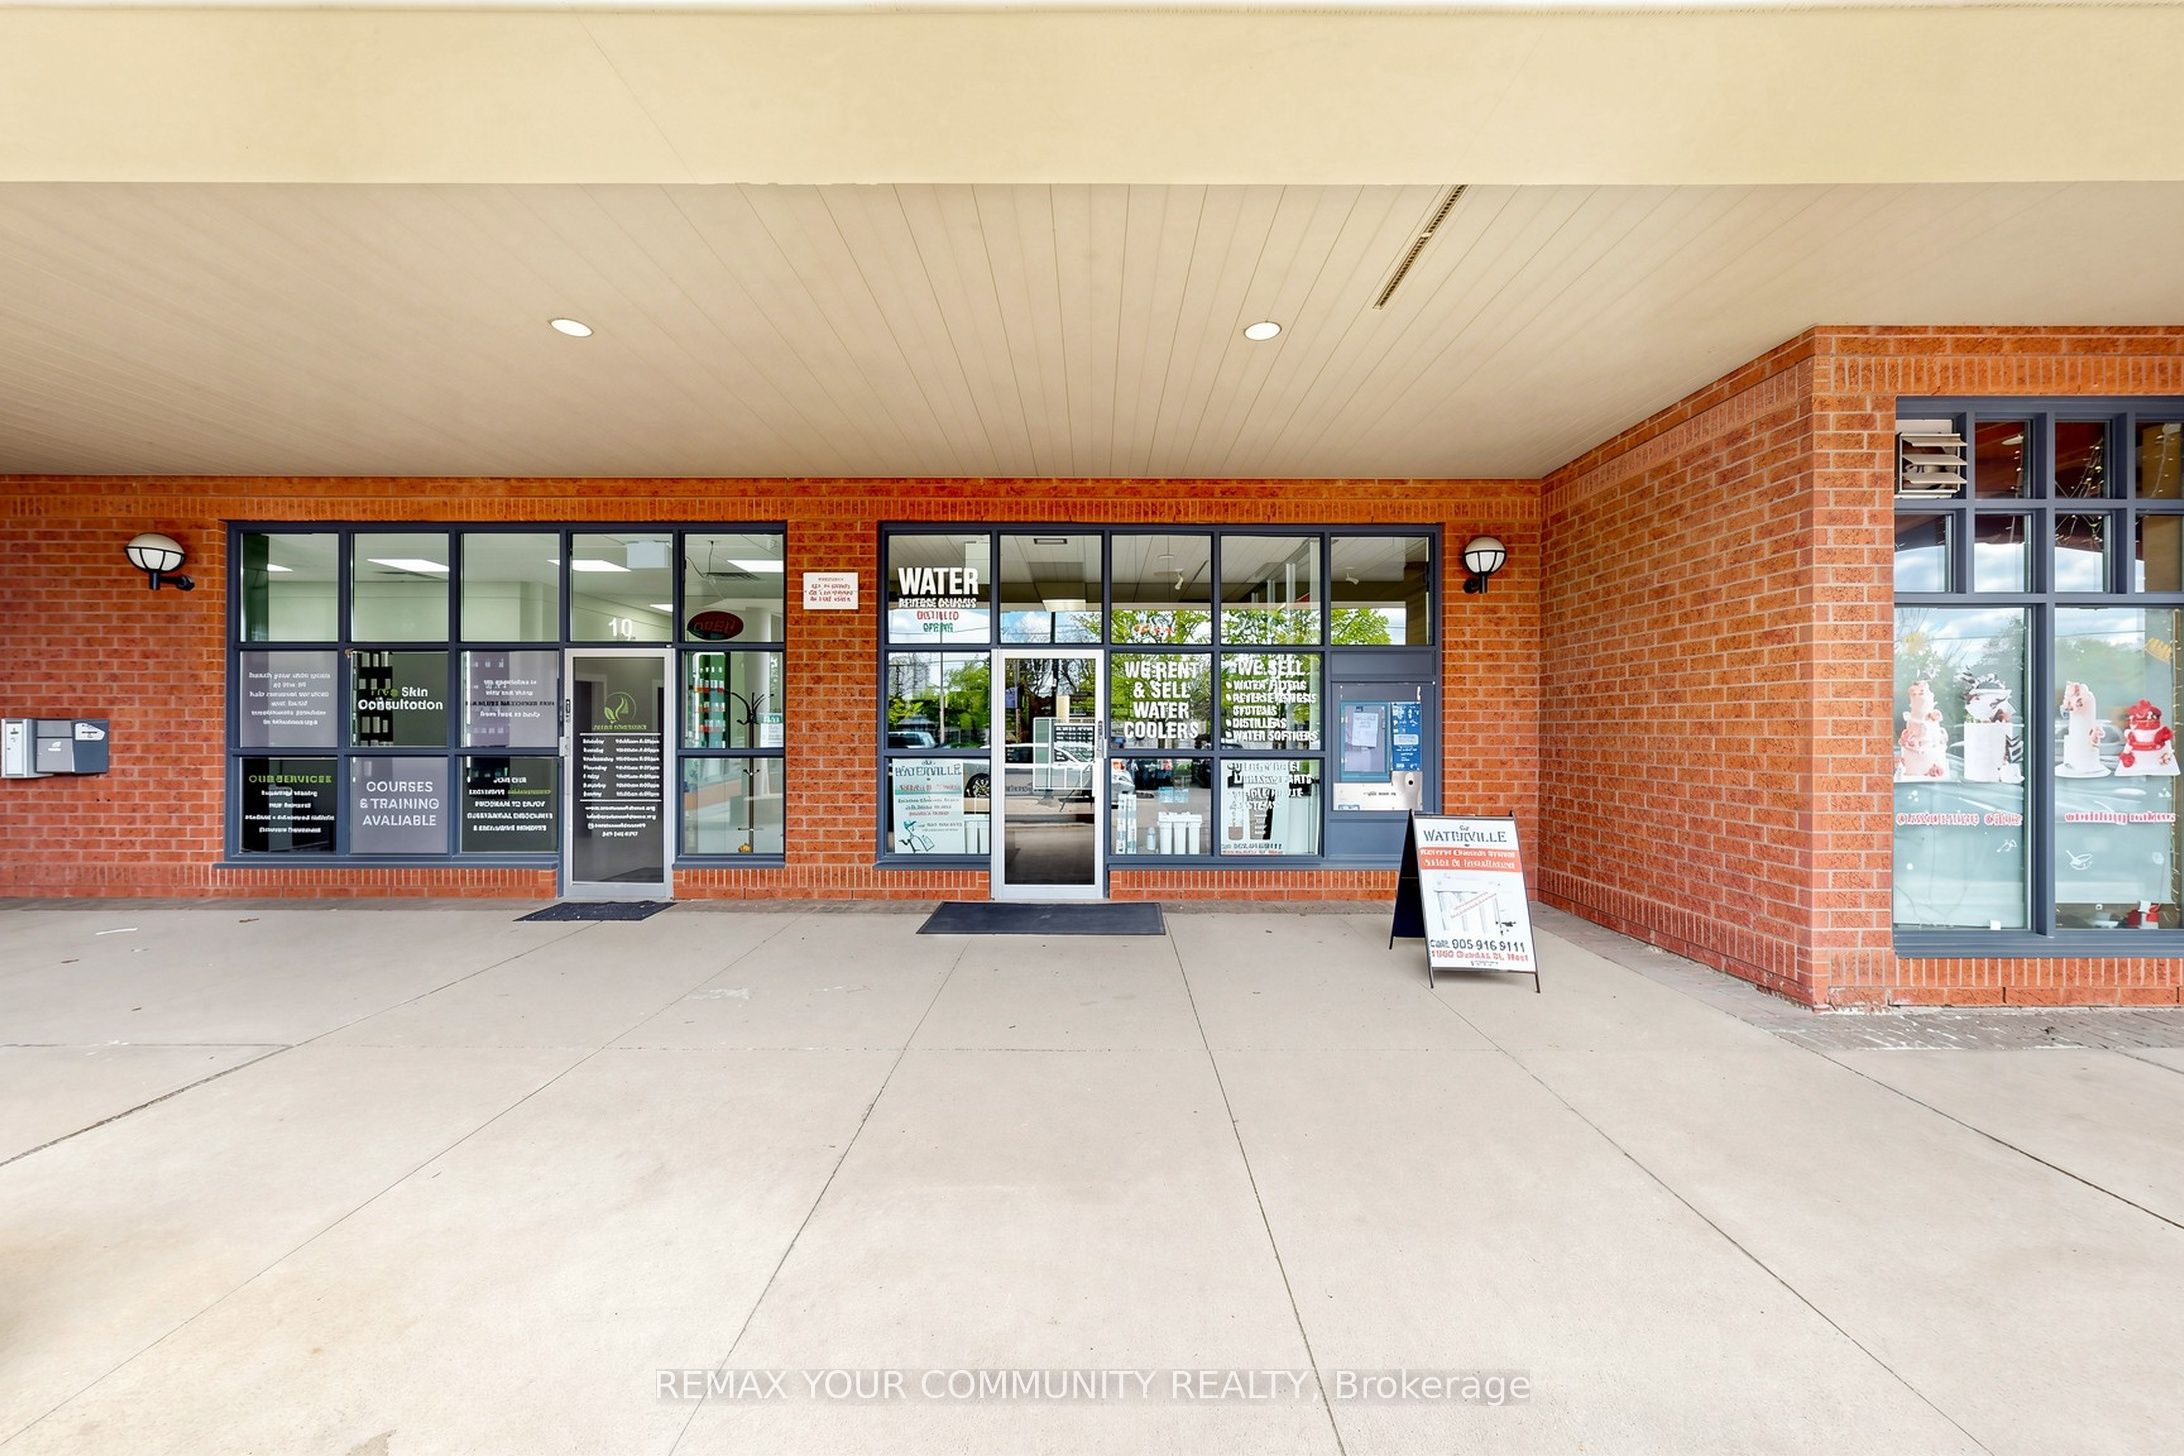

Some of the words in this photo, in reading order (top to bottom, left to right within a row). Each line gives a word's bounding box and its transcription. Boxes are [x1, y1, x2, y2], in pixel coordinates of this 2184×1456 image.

[898, 567, 979, 595] WATER
[608, 617, 633, 638] 10
[1124, 661, 1151, 679] WE
[1154, 661, 1200, 680] RENT
[1236, 659, 1265, 676] WE
[1267, 658, 1306, 677] SELL
[401, 686, 428, 697] Skin
[1133, 681, 1146, 699] &
[1149, 680, 1191, 699] SELL
[1133, 701, 1190, 719] WATER
[1123, 721, 1199, 739] COOLERS
[366, 781, 434, 793] COURSES
[360, 798, 369, 809] &
[370, 798, 440, 810] TRAINING
[362, 814, 437, 826] AVALIABLE
[1451, 938, 1474, 950] 905
[1475, 940, 1498, 951] 916
[1499, 940, 1525, 953] 9111
